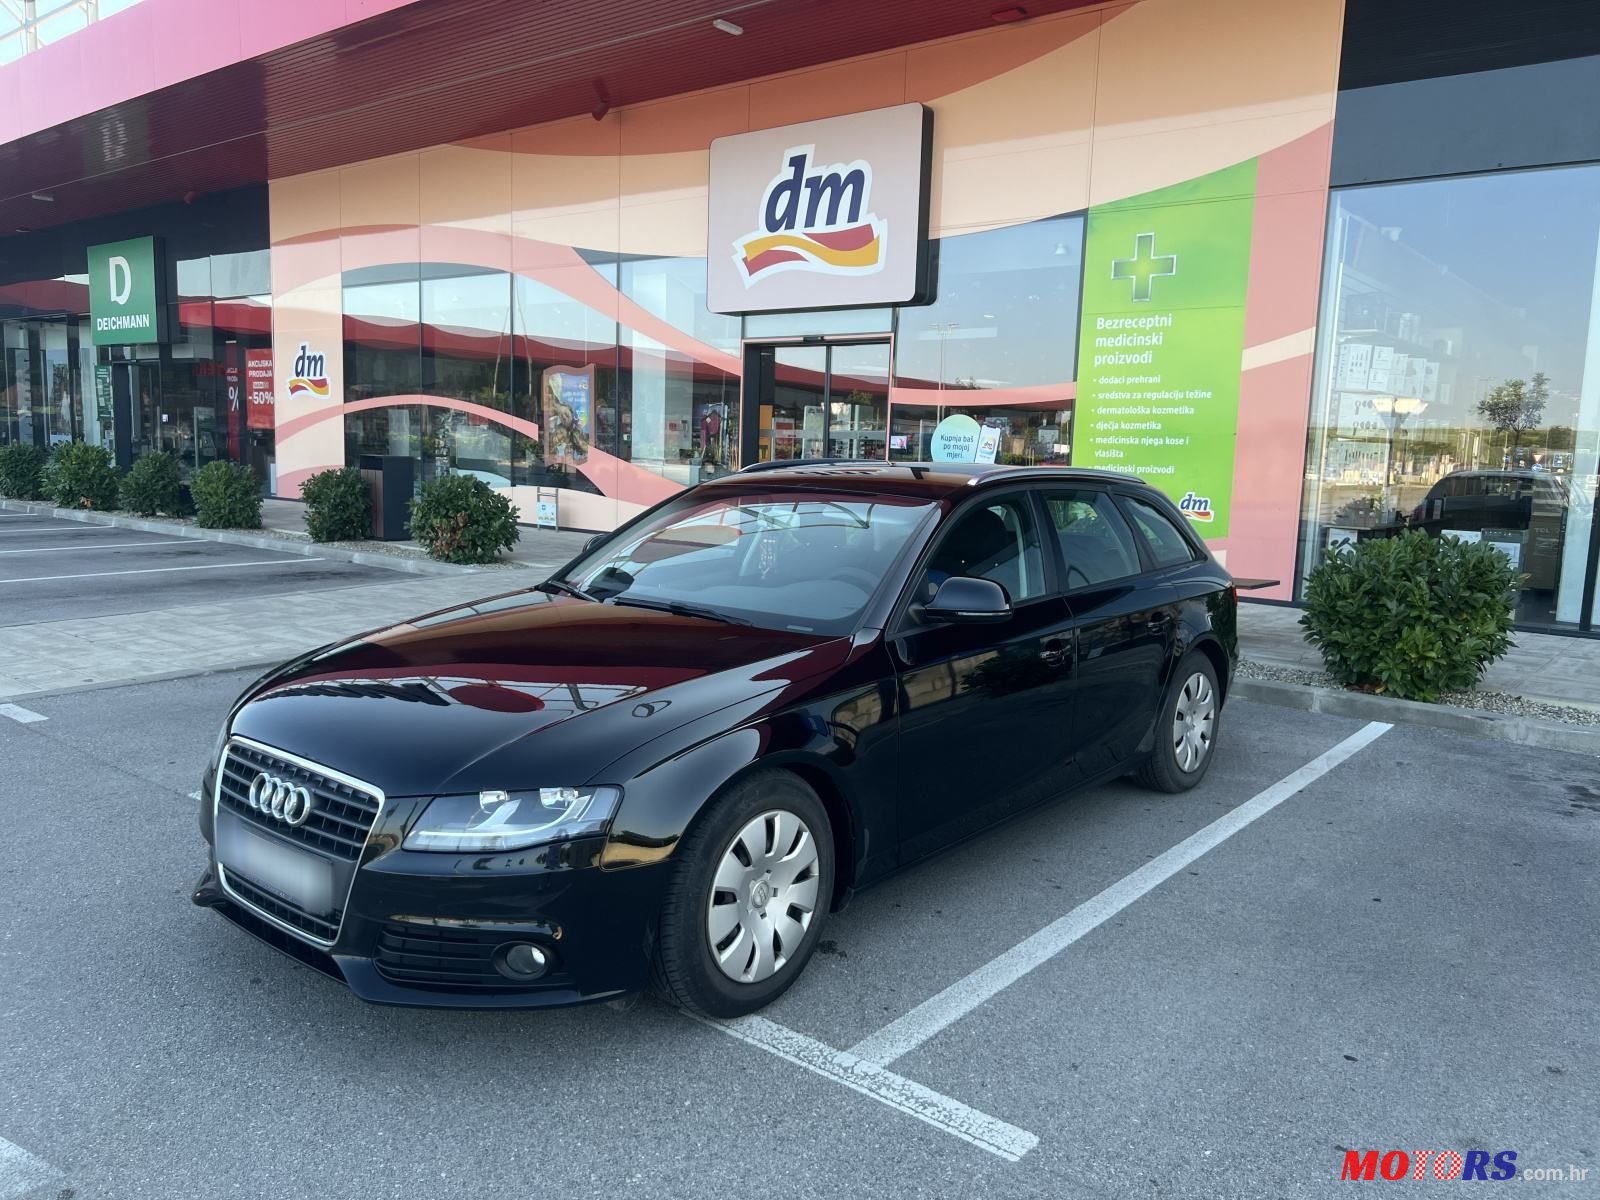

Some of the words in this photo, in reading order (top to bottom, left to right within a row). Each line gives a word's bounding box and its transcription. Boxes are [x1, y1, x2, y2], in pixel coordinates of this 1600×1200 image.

[765, 154, 865, 233] dm
[109, 256, 132, 305] D
[97, 314, 150, 331] DEICHMANN
[1096, 313, 1172, 330] Bezreceptni
[1095, 332, 1163, 347] medicinski
[295, 345, 324, 377] dm
[1094, 351, 1152, 368] proizvodi
[1099, 375, 1125, 385] dodaci
[1126, 374, 1161, 385] prehrani
[1097, 391, 1130, 399] sredstva
[1143, 390, 1184, 401] regulaciju
[1097, 405, 1150, 415] dermatološka
[1152, 405, 1195, 415] kozmetika
[1120, 420, 1162, 430] kozmetika
[941, 434, 962, 443] Kupnja
[963, 434, 974, 443] baš
[1095, 435, 1139, 445] medicinska
[1140, 436, 1163, 447] njega
[1165, 436, 1184, 445] kose
[952, 443, 969, 452] mojoj
[1136, 465, 1175, 475] proizvodi
[1181, 493, 1209, 511] dm
